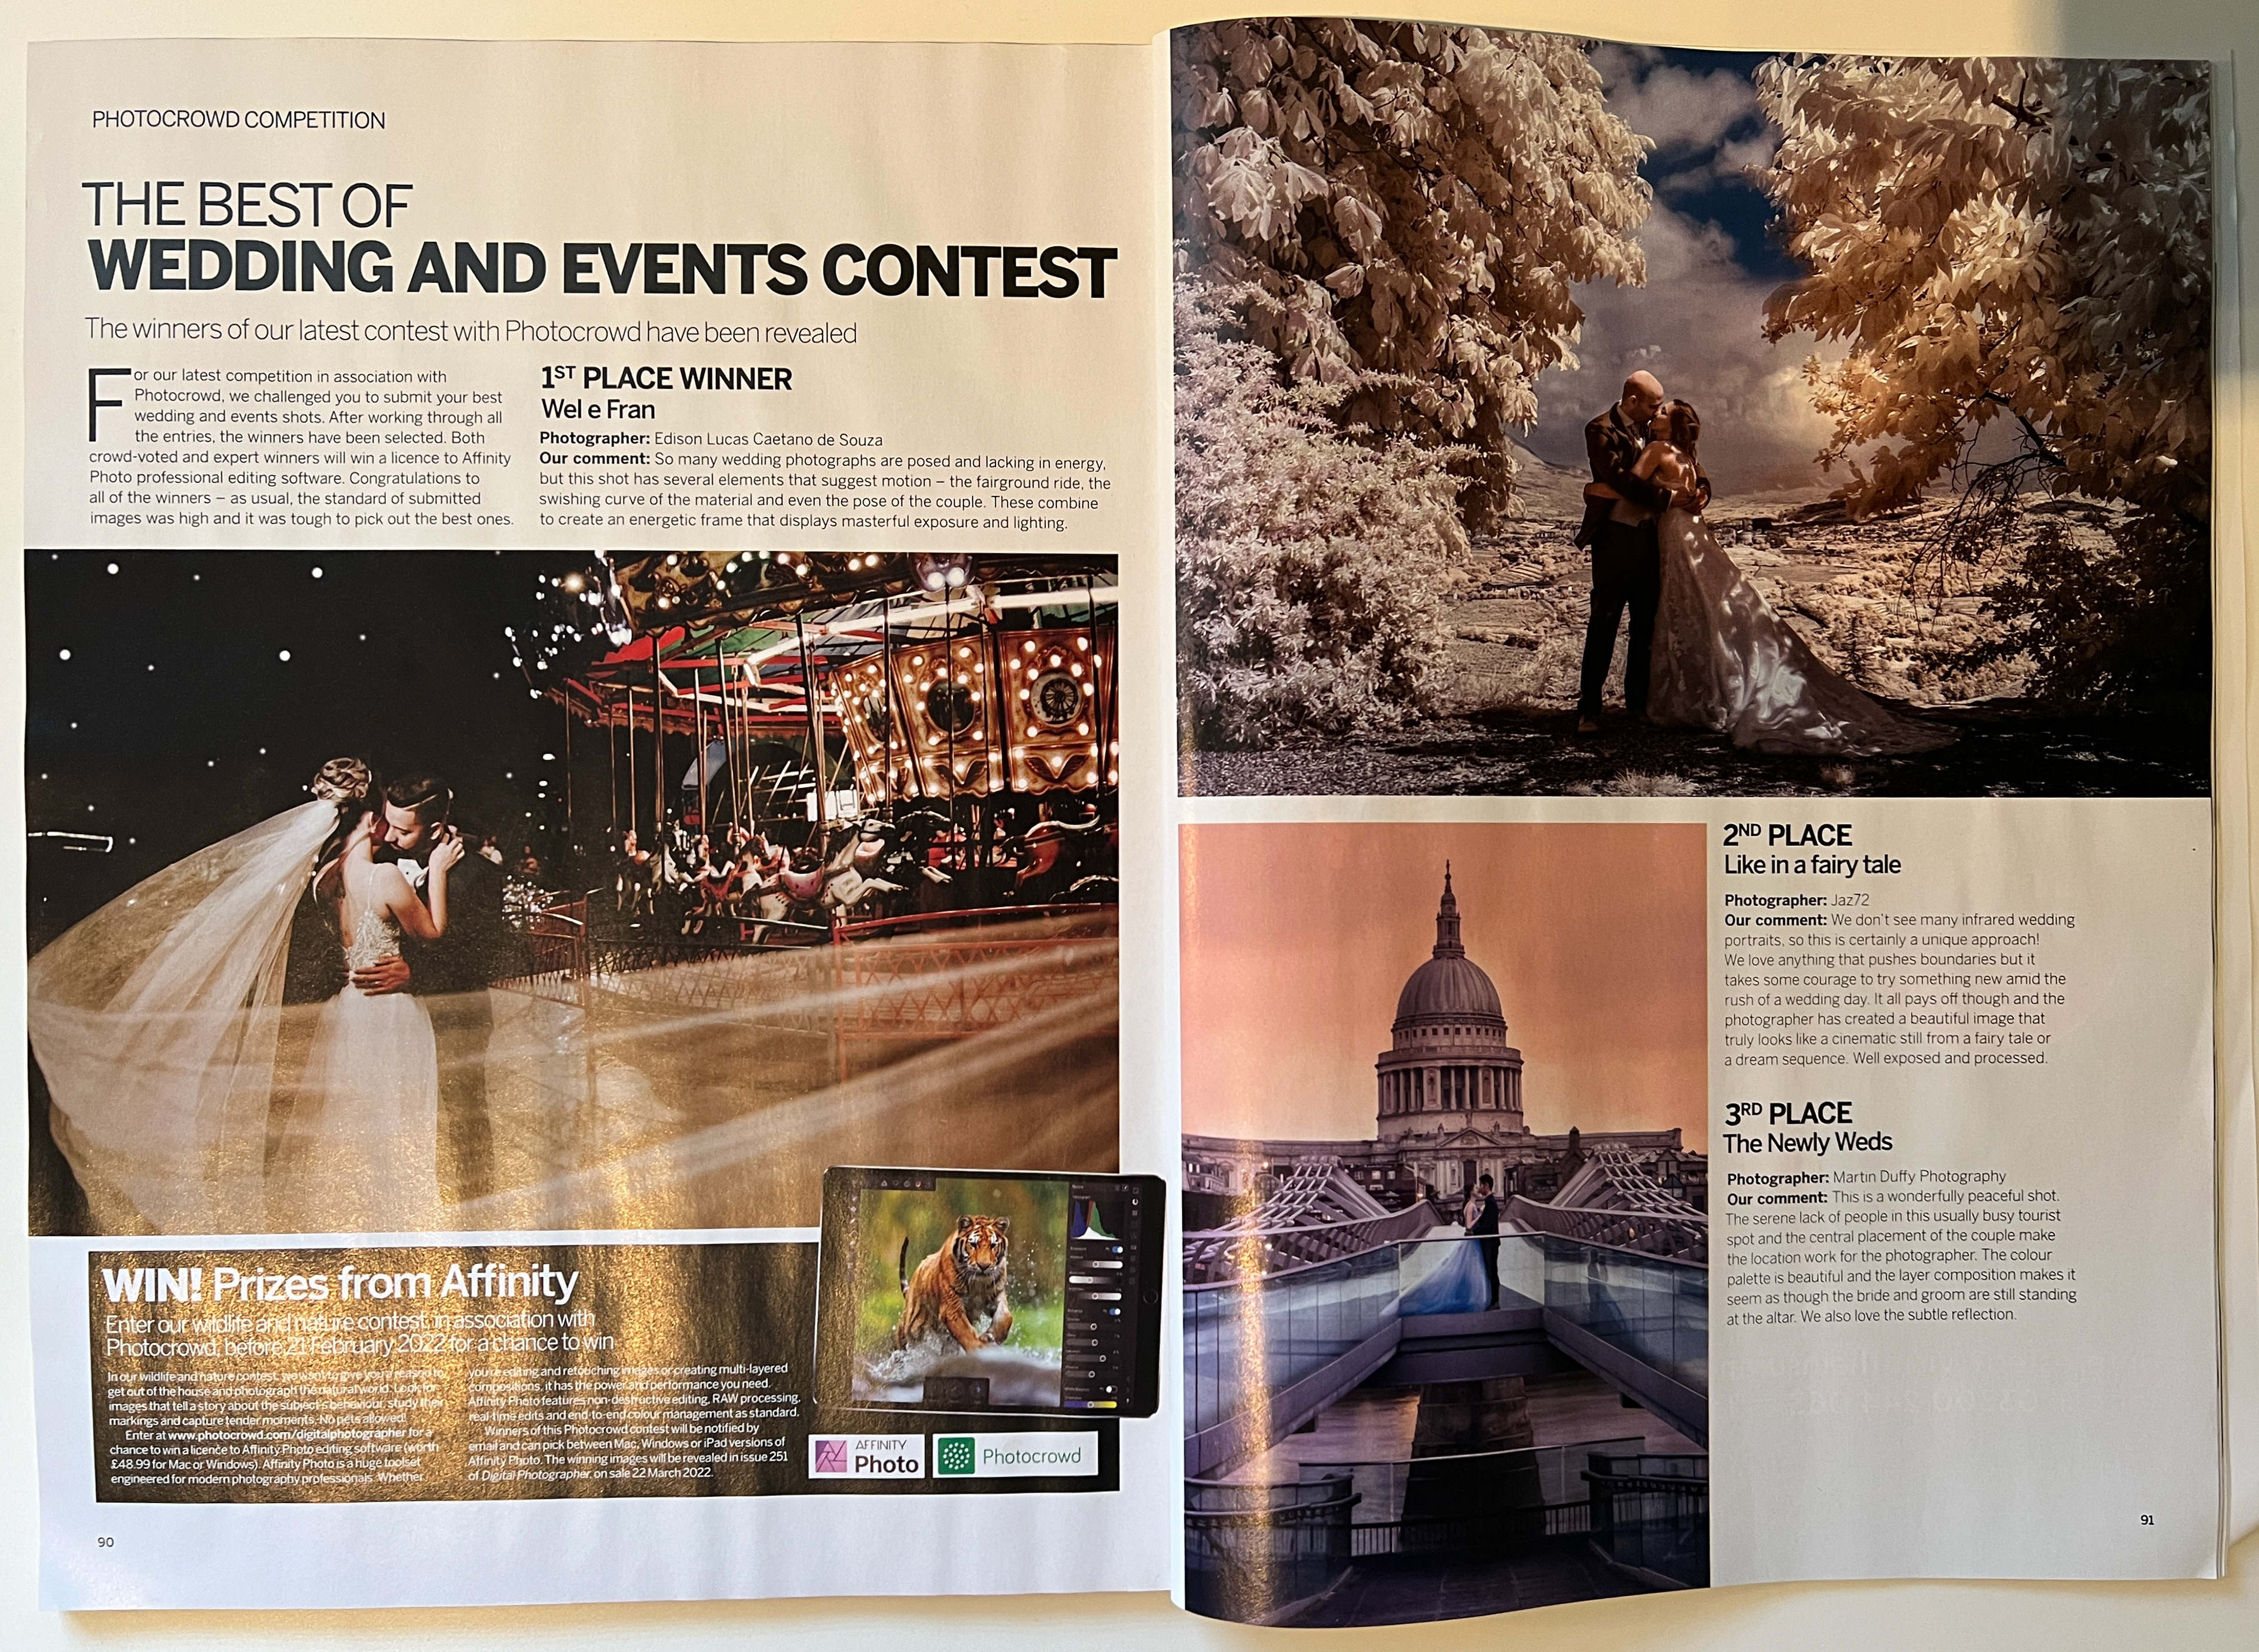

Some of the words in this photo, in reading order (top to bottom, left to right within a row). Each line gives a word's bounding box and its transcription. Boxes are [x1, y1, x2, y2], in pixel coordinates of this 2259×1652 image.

[94, 109, 239, 128] PHOTOCROWD
[245, 111, 385, 129] COMPETITION
[82, 181, 185, 226] THE
[200, 182, 333, 228] BEST
[343, 183, 414, 228] OF
[88, 238, 393, 292] WEDDING
[407, 241, 546, 293] AND
[564, 242, 808, 295] EVENTS
[823, 243, 1118, 298] CONTEST
[85, 317, 128, 338] The
[133, 318, 222, 339] winners
[228, 318, 250, 339] of
[255, 324, 294, 340] our
[300, 319, 359, 341] latest
[365, 320, 448, 341] contest
[454, 320, 499, 341] with
[507, 320, 641, 342] Photocrowd
[648, 321, 699, 342] have
[705, 321, 759, 342] been
[766, 322, 857, 343] revealed
[154, 371, 177, 381] our
[182, 368, 221, 381] latest
[226, 370, 312, 385] competition
[318, 370, 329, 382] in
[334, 370, 412, 383] association
[417, 371, 446, 382] with
[542, 365, 577, 388] 1ST
[584, 367, 673, 389] PLACE
[679, 367, 792, 390] WINNER
[135, 388, 224, 403] Photocrowd,
[229, 392, 249, 402] we
[254, 390, 330, 406] challenged
[335, 394, 360, 406] you
[365, 391, 379, 403] to
[384, 391, 432, 403] submit
[437, 394, 468, 406] your
[473, 391, 502, 403] best
[541, 398, 581, 418] Wel
[588, 404, 601, 419] e
[608, 399, 655, 419] Fran
[540, 431, 649, 447] Photographer:
[655, 432, 702, 445] Edison
[708, 432, 748, 445] Lucas
[754, 432, 812, 445] Caetano
[818, 434, 834, 446] de
[839, 434, 882, 446] Souza
[540, 451, 568, 464] Our
[574, 452, 650, 464] comment:
[655, 452, 674, 465] So
[679, 456, 718, 468] many
[722, 453, 781, 468] wedding
[787, 453, 876, 469] photographs
[881, 457, 902, 467] are
[908, 455, 950, 469] posed
[955, 455, 980, 468] and
[986, 455, 1034, 471] lacking
[1039, 457, 1050, 468] in
[1055, 459, 1105, 472] energy,
[1723, 823, 1761, 846] 2ND
[1769, 824, 1852, 846] PLACE
[1725, 854, 1766, 874] Like
[1771, 855, 1789, 874] in
[1794, 860, 1806, 874] a
[1811, 854, 1858, 878] fairy
[1862, 854, 1901, 874] tale
[1725, 894, 1827, 909] Photographer:
[1831, 894, 1869, 906] Jaz72
[1725, 914, 1751, 926] Our
[1756, 914, 1827, 926] comment:
[1831, 914, 1851, 925] We
[1894, 917, 1916, 925] see
[1921, 917, 1958, 928] many
[1963, 913, 2014, 925] infrared
[2018, 913, 2075, 928] wedding
[1725, 1103, 1762, 1126] 3RD
[1770, 1101, 1853, 1125] PLACE
[1722, 1134, 1762, 1154] The
[1768, 1132, 1831, 1157] Newly
[1835, 1131, 1893, 1151] Weds
[1728, 1171, 1829, 1187] Photographer:
[1834, 1171, 1875, 1183] Martin
[1881, 1170, 1915, 1185] Duffy
[1920, 1170, 2006, 1185] Photography
[1728, 1193, 1753, 1205] Our
[1757, 1191, 1827, 1204] comment:
[1832, 1191, 1859, 1203] This
[1864, 1193, 1872, 1203] is
[1877, 1193, 1884, 1202] a
[1888, 1190, 1964, 1204] wonderfully
[1968, 1189, 2023, 1204] peaceful
[2028, 1190, 2060, 1201] shot.
[102, 1268, 202, 1303] WIN!
[214, 1267, 328, 1301] Prizes
[339, 1265, 430, 1299] from
[441, 1263, 579, 1305] Affinity
[106, 1315, 155, 1333] Enter
[158, 1318, 188, 1333] our
[193, 1314, 251, 1333] wildlife
[256, 1314, 291, 1333] and
[295, 1315, 354, 1331] nature
[435, 1312, 449, 1329] in
[454, 1311, 553, 1329] association
[558, 1310, 595, 1327] with
[107, 1338, 220, 1357] Photocrowd,
[225, 1337, 282, 1355] before
[287, 1338, 305, 1354] 21
[310, 1336, 394, 1357] February
[398, 1334, 446, 1353] 2022
[450, 1333, 473, 1353] for
[478, 1337, 489, 1351] a
[493, 1333, 558, 1352] chance
[562, 1334, 579, 1351] to
[584, 1333, 614, 1350] win
[125, 1430, 154, 1440] Enter
[156, 1431, 166, 1440] at
[409, 1427, 422, 1437] for
[855, 1440, 907, 1450] AFFINITY
[111, 1459, 151, 1470] £48.99
[152, 1459, 166, 1469] for
[169, 1460, 191, 1470] Mac
[262, 1458, 300, 1471] Affinity
[302, 1458, 334, 1468] Photo
[336, 1459, 345, 1468] is
[355, 1458, 382, 1470] huge
[384, 1457, 421, 1467] toolset
[984, 1447, 1081, 1464] Photocrowd
[468, 1470, 478, 1481] of
[609, 1468, 630, 1478] sale
[632, 1468, 646, 1478] 22
[648, 1467, 681, 1478] March
[683, 1467, 714, 1478] 2022.
[855, 1456, 918, 1474] Photo
[2141, 1515, 2154, 1525] 91
[98, 1537, 114, 1547] 90
